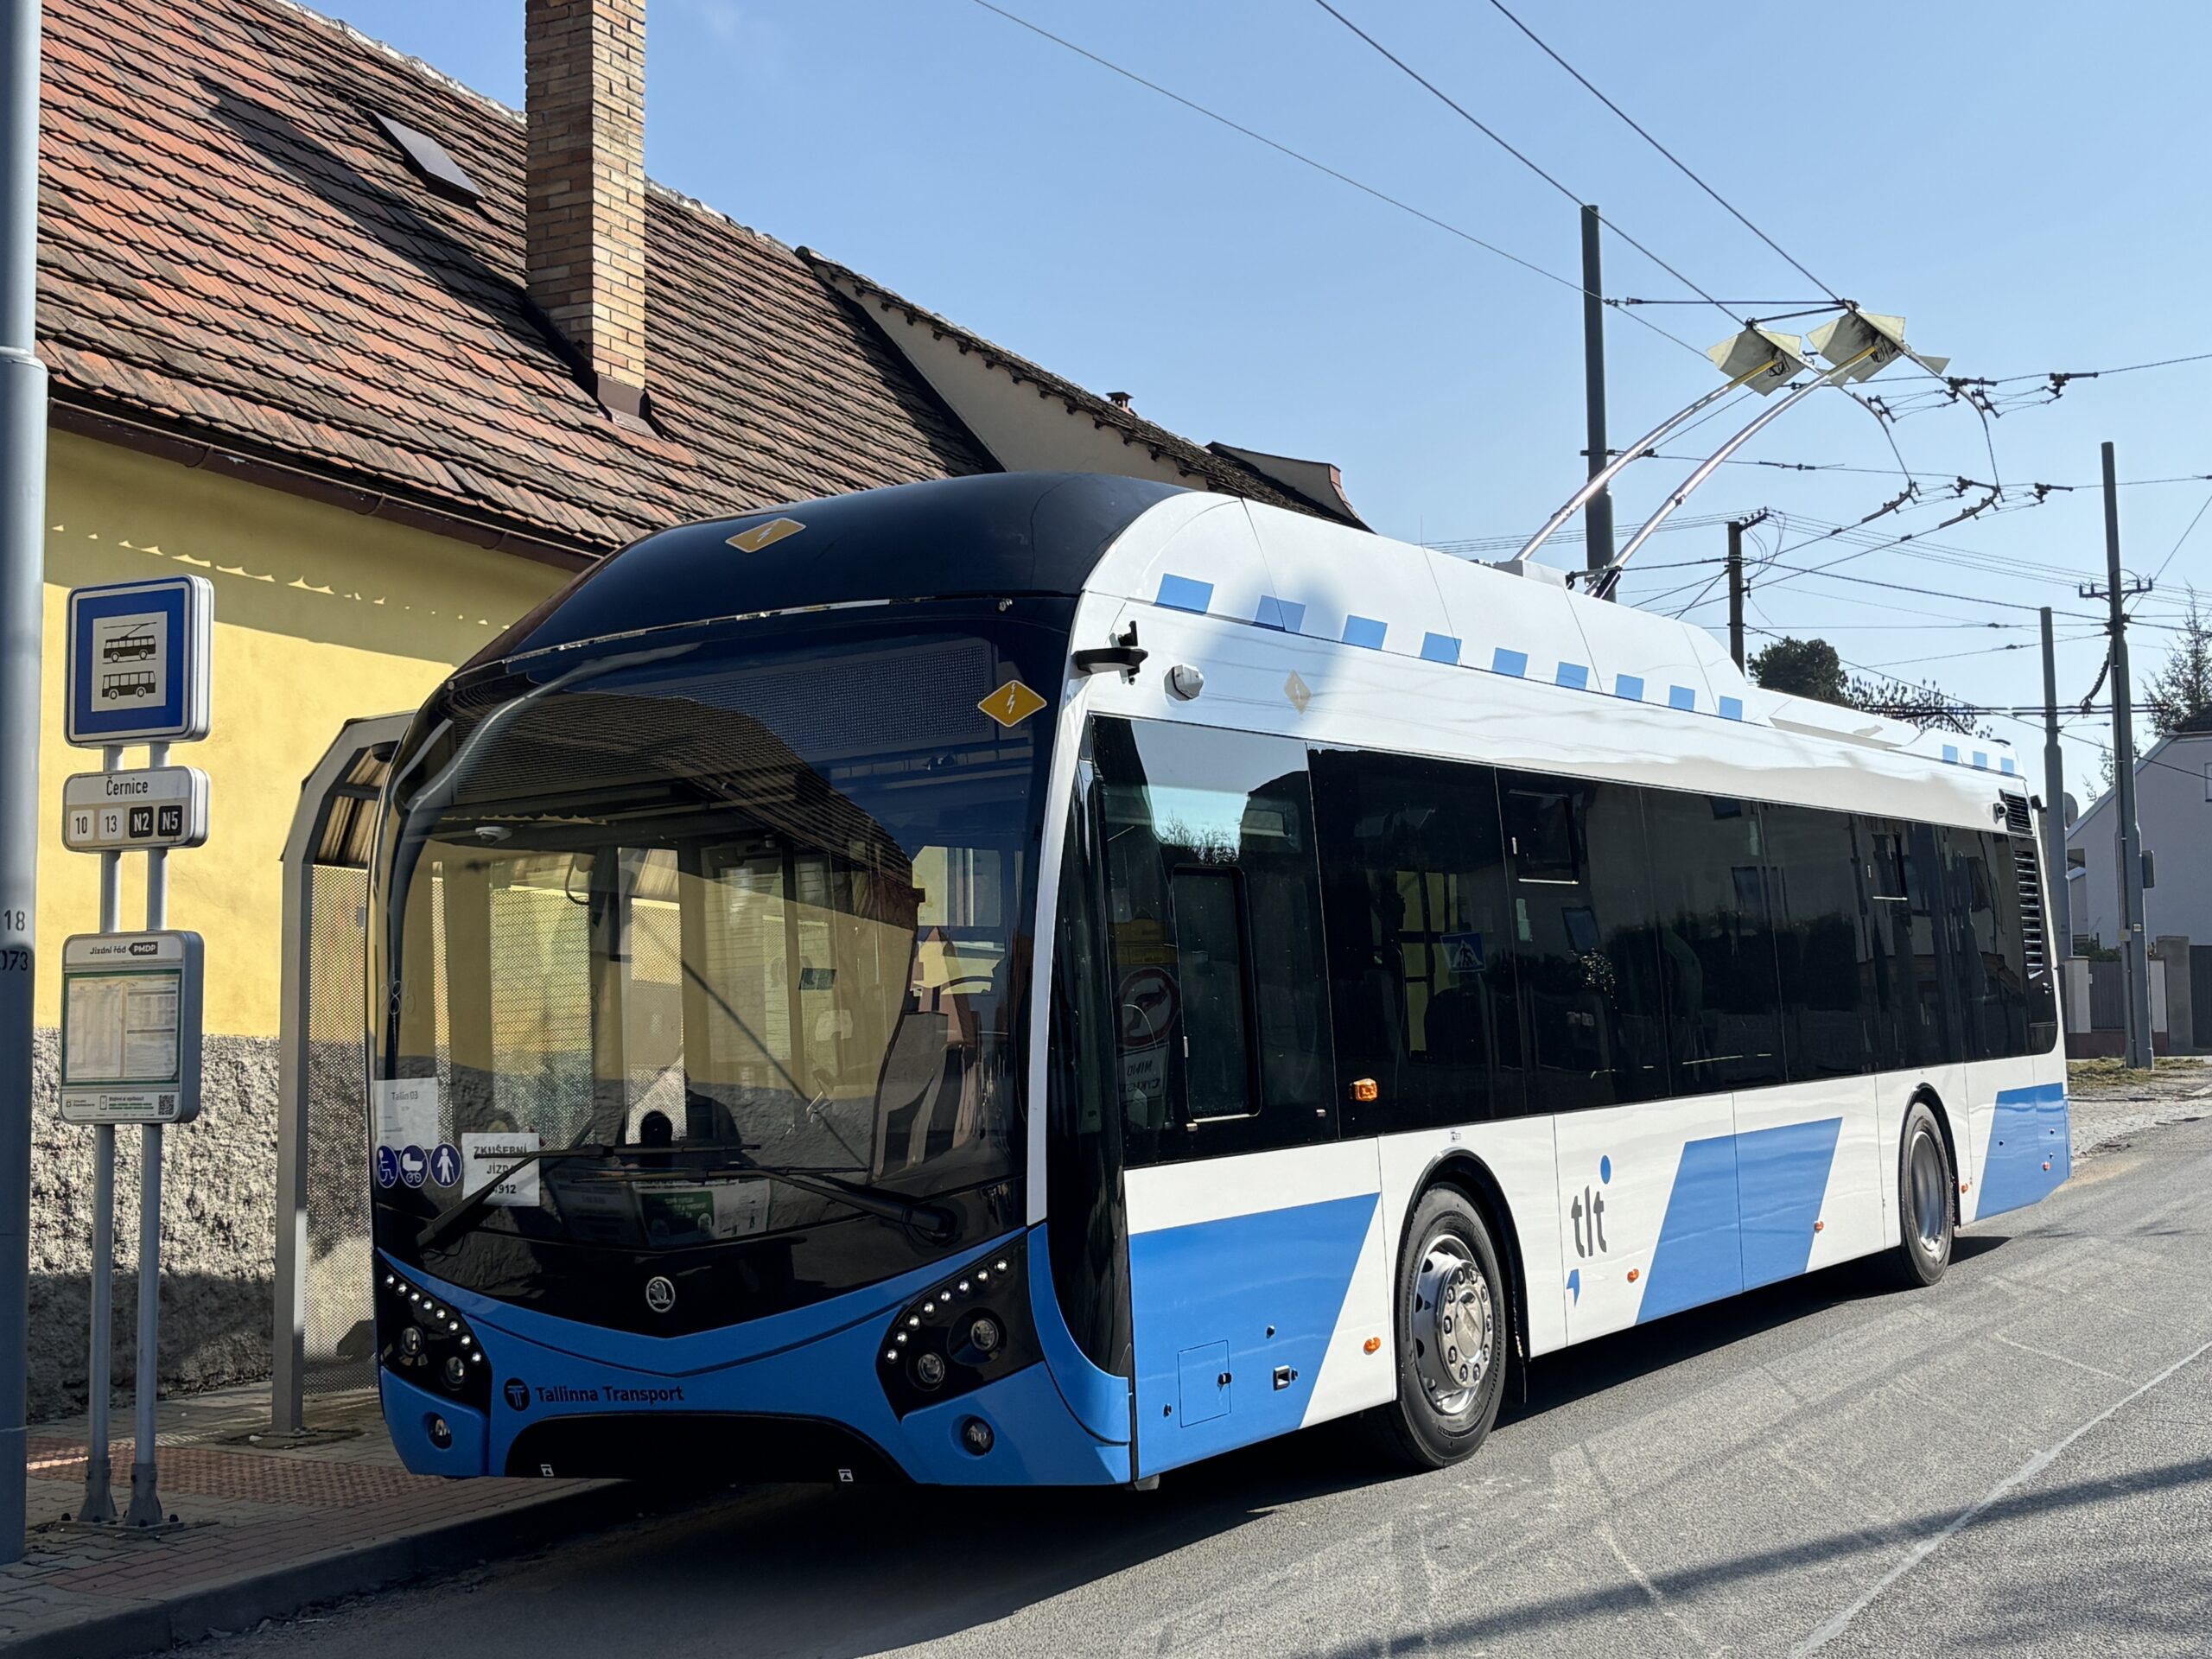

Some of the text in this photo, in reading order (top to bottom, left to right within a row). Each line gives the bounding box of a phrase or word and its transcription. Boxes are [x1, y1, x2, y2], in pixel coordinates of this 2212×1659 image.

[106, 776, 149, 796] Černice
[76, 810, 179, 835] 10 13 N2 N5
[4, 909, 25, 931] 18
[486, 1162, 515, 1174] JÍZD
[1571, 1185, 1607, 1258] tlt
[535, 1385, 599, 1403] Tallinna
[602, 1385, 684, 1405] Transport
